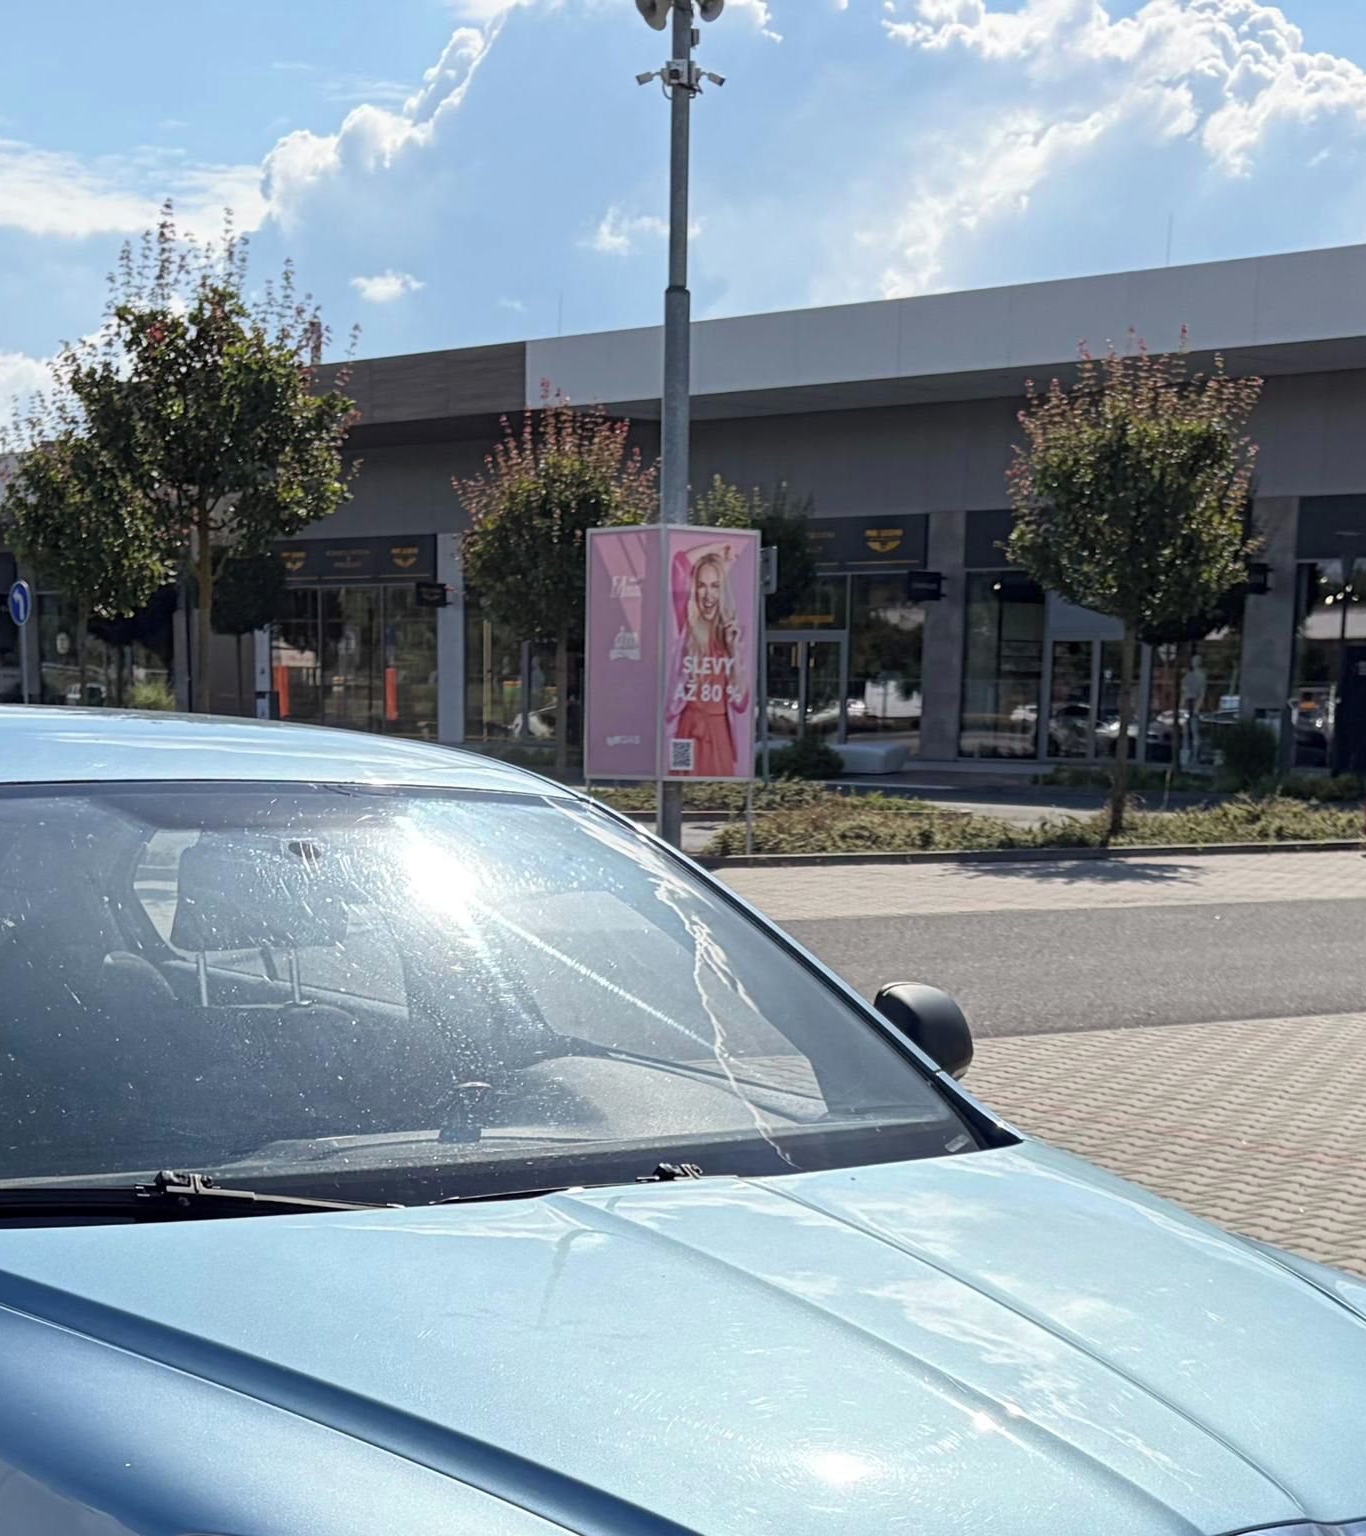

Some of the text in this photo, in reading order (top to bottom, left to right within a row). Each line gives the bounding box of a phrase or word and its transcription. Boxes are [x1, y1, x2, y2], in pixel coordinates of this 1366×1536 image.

[682, 656, 736, 675] SLEVY
[700, 683, 722, 702] 80
[727, 686, 742, 703] %
